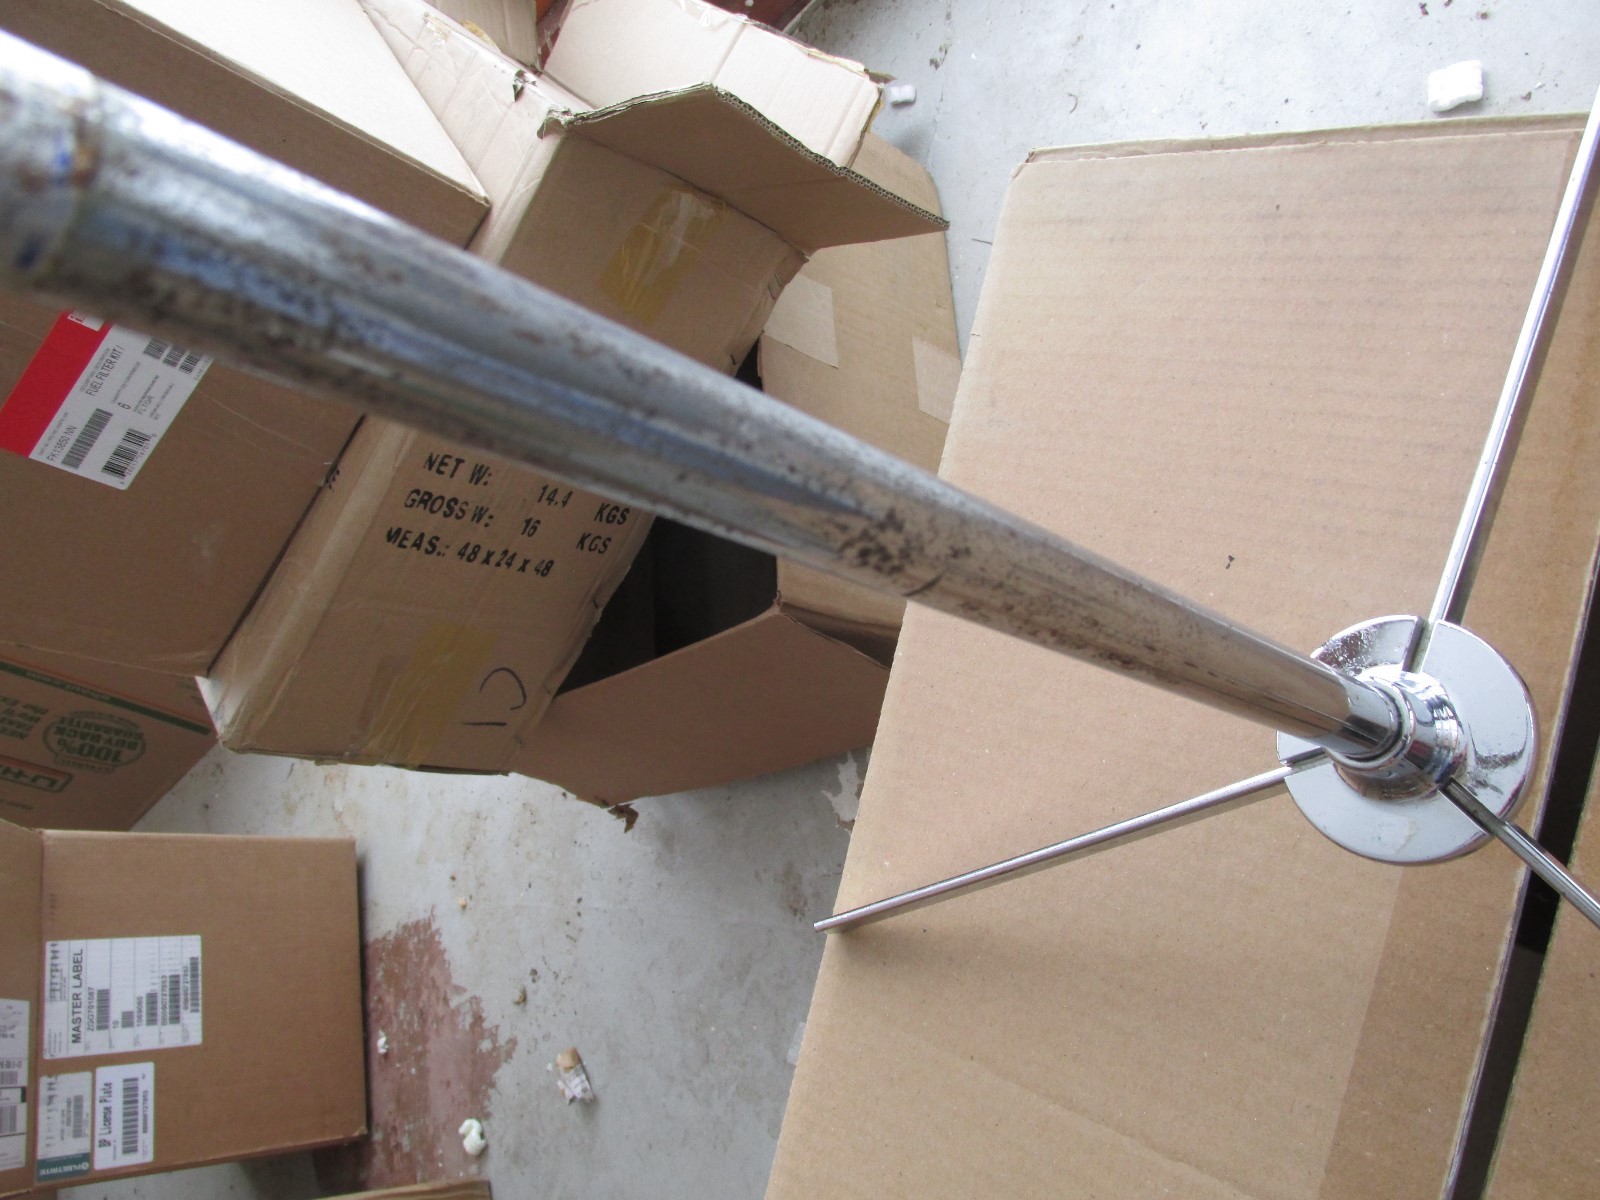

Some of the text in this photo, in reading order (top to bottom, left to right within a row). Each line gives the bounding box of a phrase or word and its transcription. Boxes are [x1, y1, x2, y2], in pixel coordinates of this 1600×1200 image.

[85, 380, 103, 397] FUEL
[96, 359, 117, 381] FILTER
[109, 348, 123, 360] KIT
[118, 402, 131, 410] 6
[424, 452, 630, 526] NET W: 14.4 KGS
[404, 489, 612, 555] GROSS W: 16 KGS
[386, 526, 449, 557] MEAS.:
[457, 542, 481, 563] 48
[494, 549, 516, 569] 24
[534, 559, 555, 577] 48
[57, 737, 122, 764] 100%
[0, 764, 58, 788] U-H
[71, 949, 83, 1044] MASTER LABEL
[99, 1082, 112, 1104] Plate
[99, 1106, 112, 1136] License
